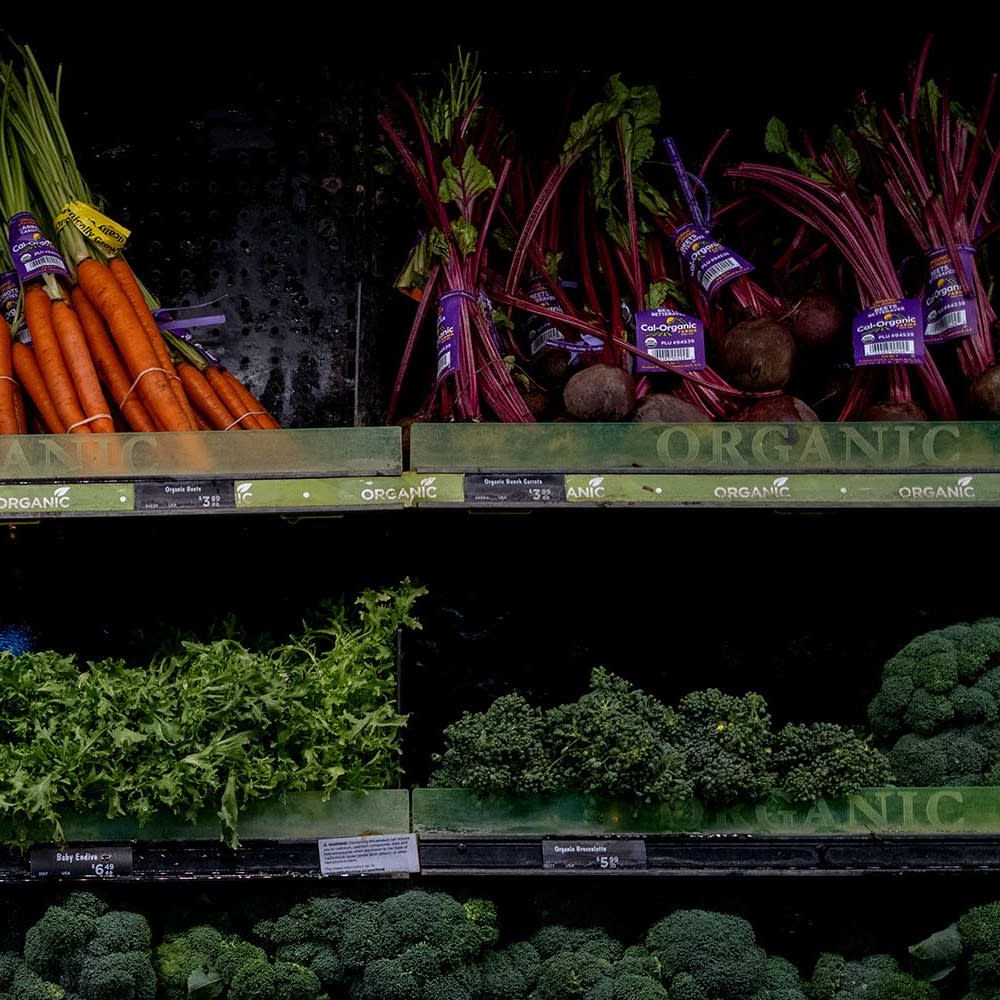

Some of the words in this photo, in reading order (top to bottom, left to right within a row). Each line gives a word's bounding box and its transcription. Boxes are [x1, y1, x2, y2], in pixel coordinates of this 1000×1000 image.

[641, 321, 697, 334] Cal-Organic
[857, 315, 917, 333] Cal-Organic
[656, 425, 962, 466] ORGANIC
[165, 486, 186, 494] Organic
[361, 487, 437, 500] ORGANIC
[714, 486, 791, 498] ORGANIC
[899, 486, 975, 498] ORGANIC
[56, 853, 73, 863] Baby
[75, 853, 98, 861] Endive
